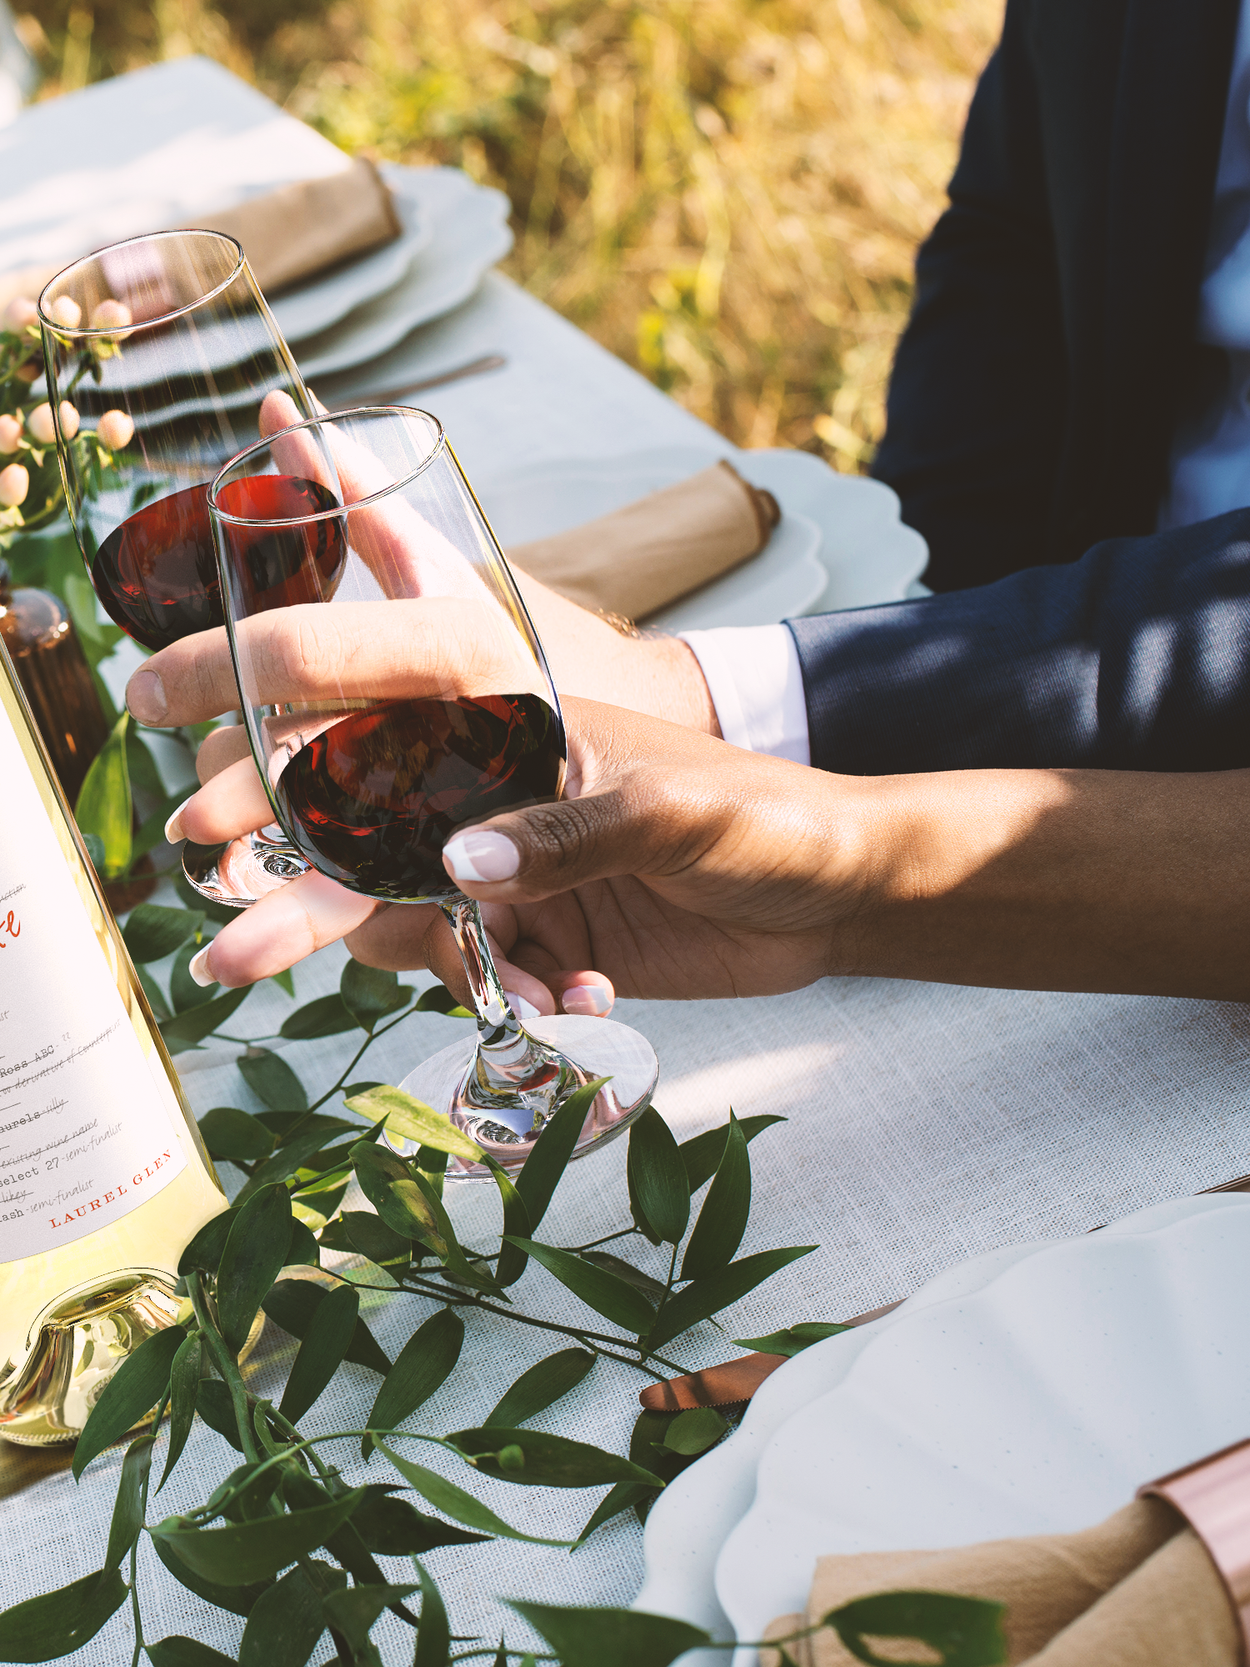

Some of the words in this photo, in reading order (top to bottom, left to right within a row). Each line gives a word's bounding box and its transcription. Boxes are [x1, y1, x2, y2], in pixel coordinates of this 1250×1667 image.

[0, 1060, 29, 1078] Ross
[34, 1045, 55, 1062] ABC
[45, 1156, 61, 1171] 27
[48, 1185, 128, 1230] LAUREL
[132, 1149, 172, 1186] GLEN
